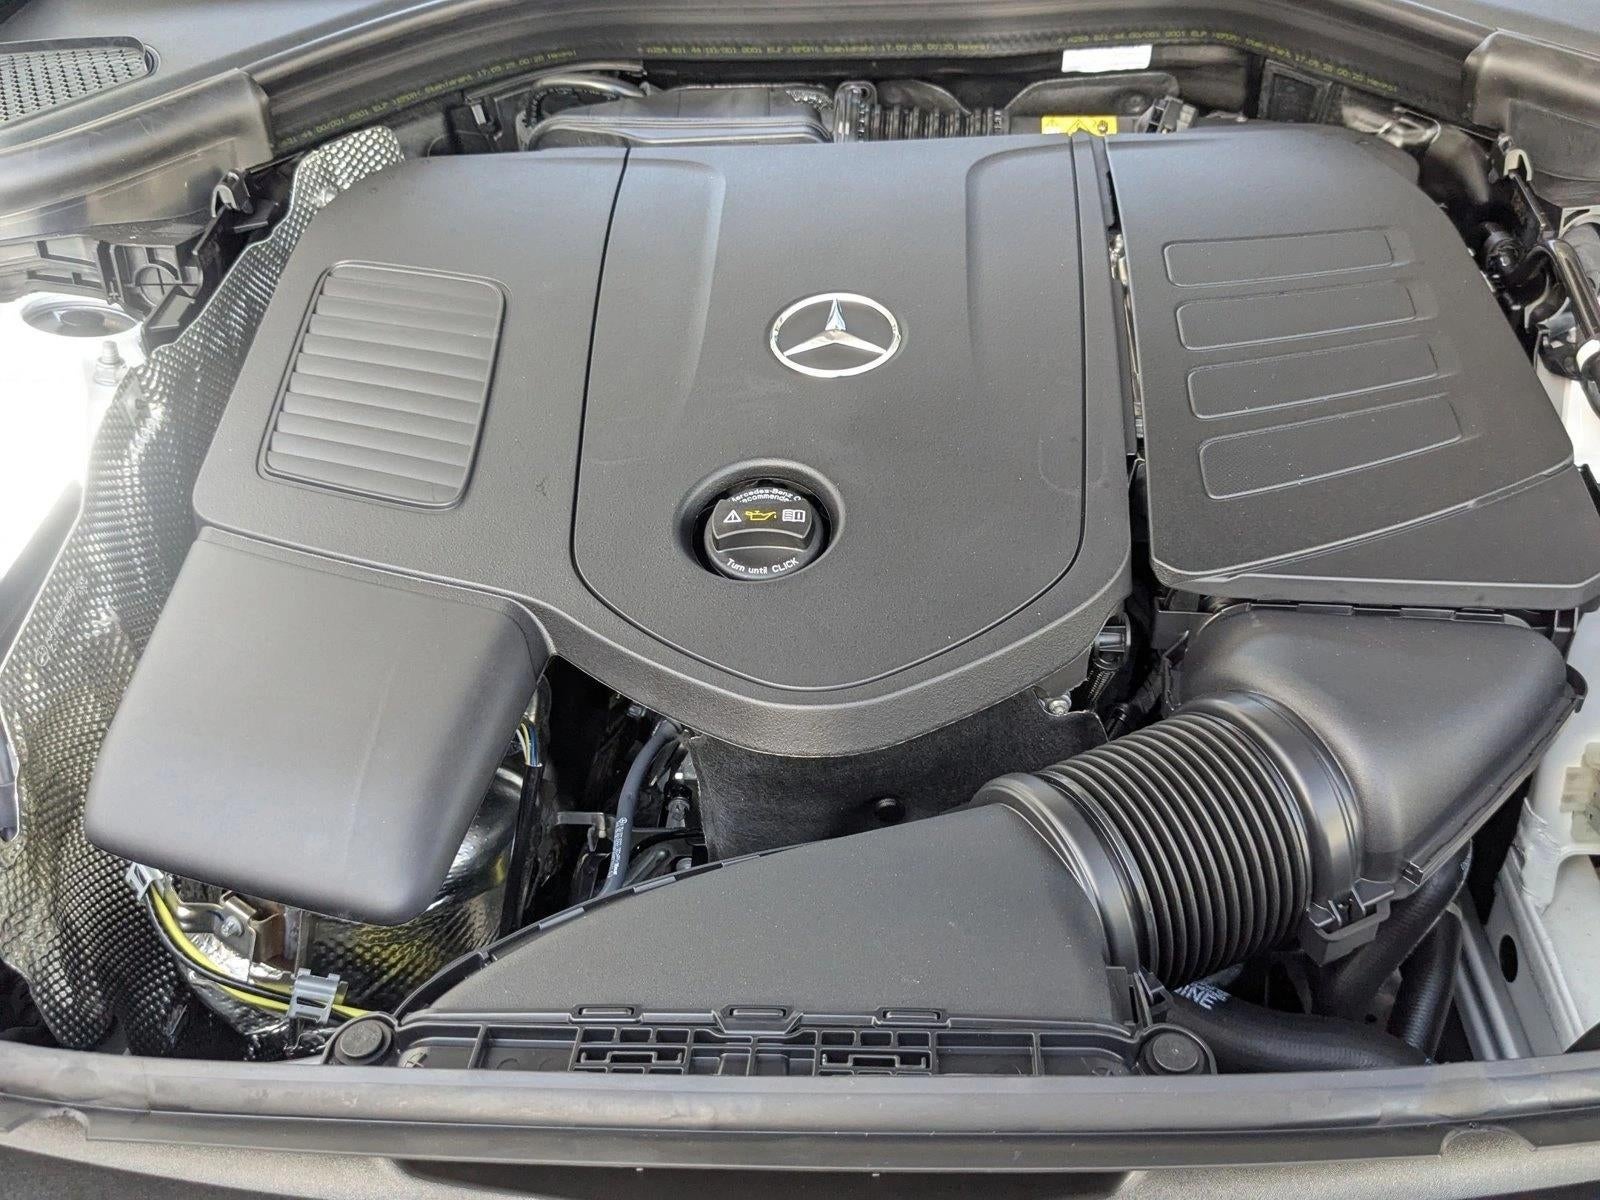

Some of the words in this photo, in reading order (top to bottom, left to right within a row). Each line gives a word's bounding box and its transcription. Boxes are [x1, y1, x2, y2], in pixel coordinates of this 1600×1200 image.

[727, 558, 746, 572] Turn
[748, 566, 768, 575] until
[771, 557, 799, 573] CLICK
